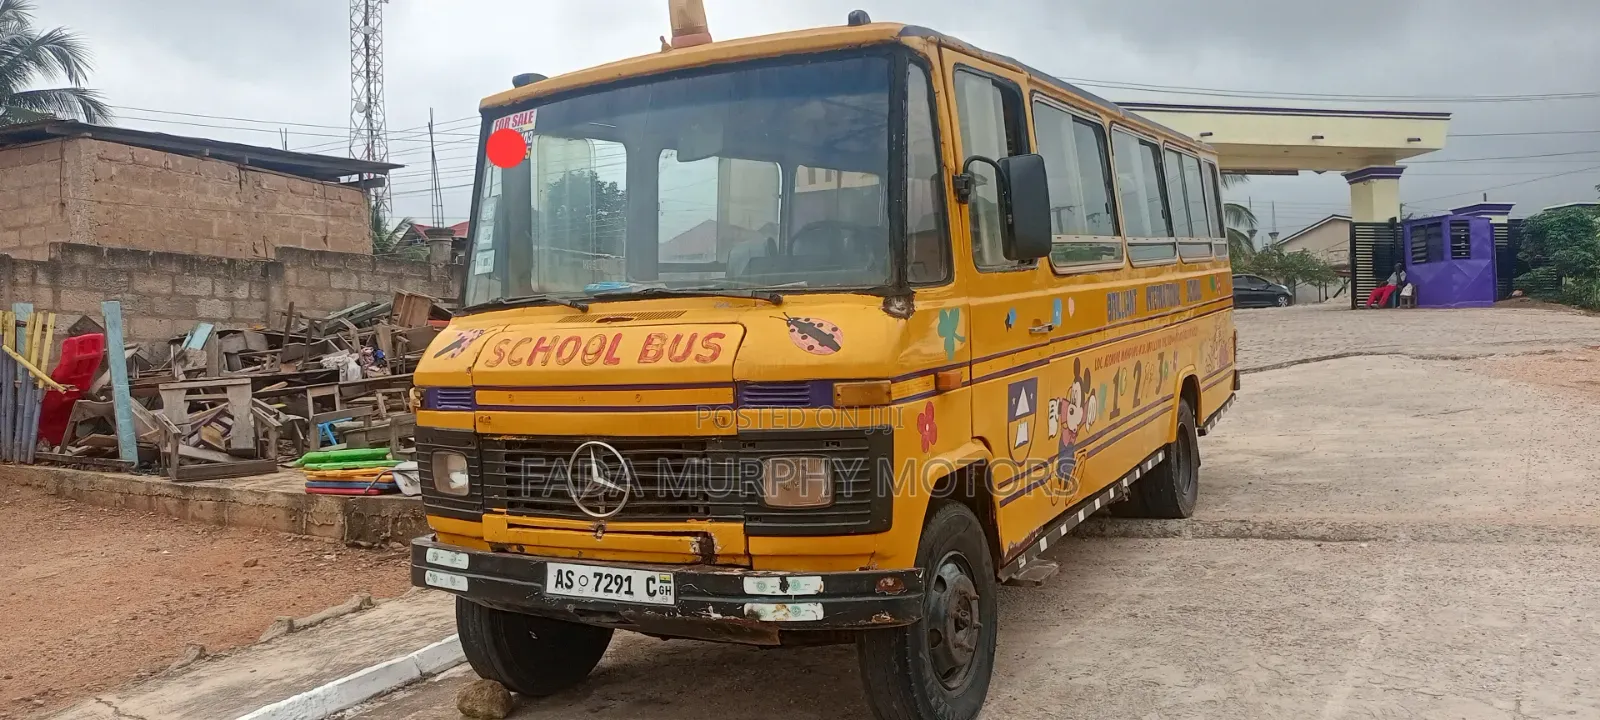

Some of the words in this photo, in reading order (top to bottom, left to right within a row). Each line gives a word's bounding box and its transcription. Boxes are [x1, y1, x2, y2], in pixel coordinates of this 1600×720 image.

[495, 117, 510, 131] FOR
[512, 111, 534, 127] SALE
[484, 332, 623, 367] SCHOOL
[637, 332, 726, 365] BUS
[1109, 366, 1120, 421] 1
[1133, 360, 1142, 409] 2
[555, 568, 574, 590] AS
[593, 572, 634, 596] 7291
[646, 575, 657, 597] C
[658, 585, 672, 596] GH
